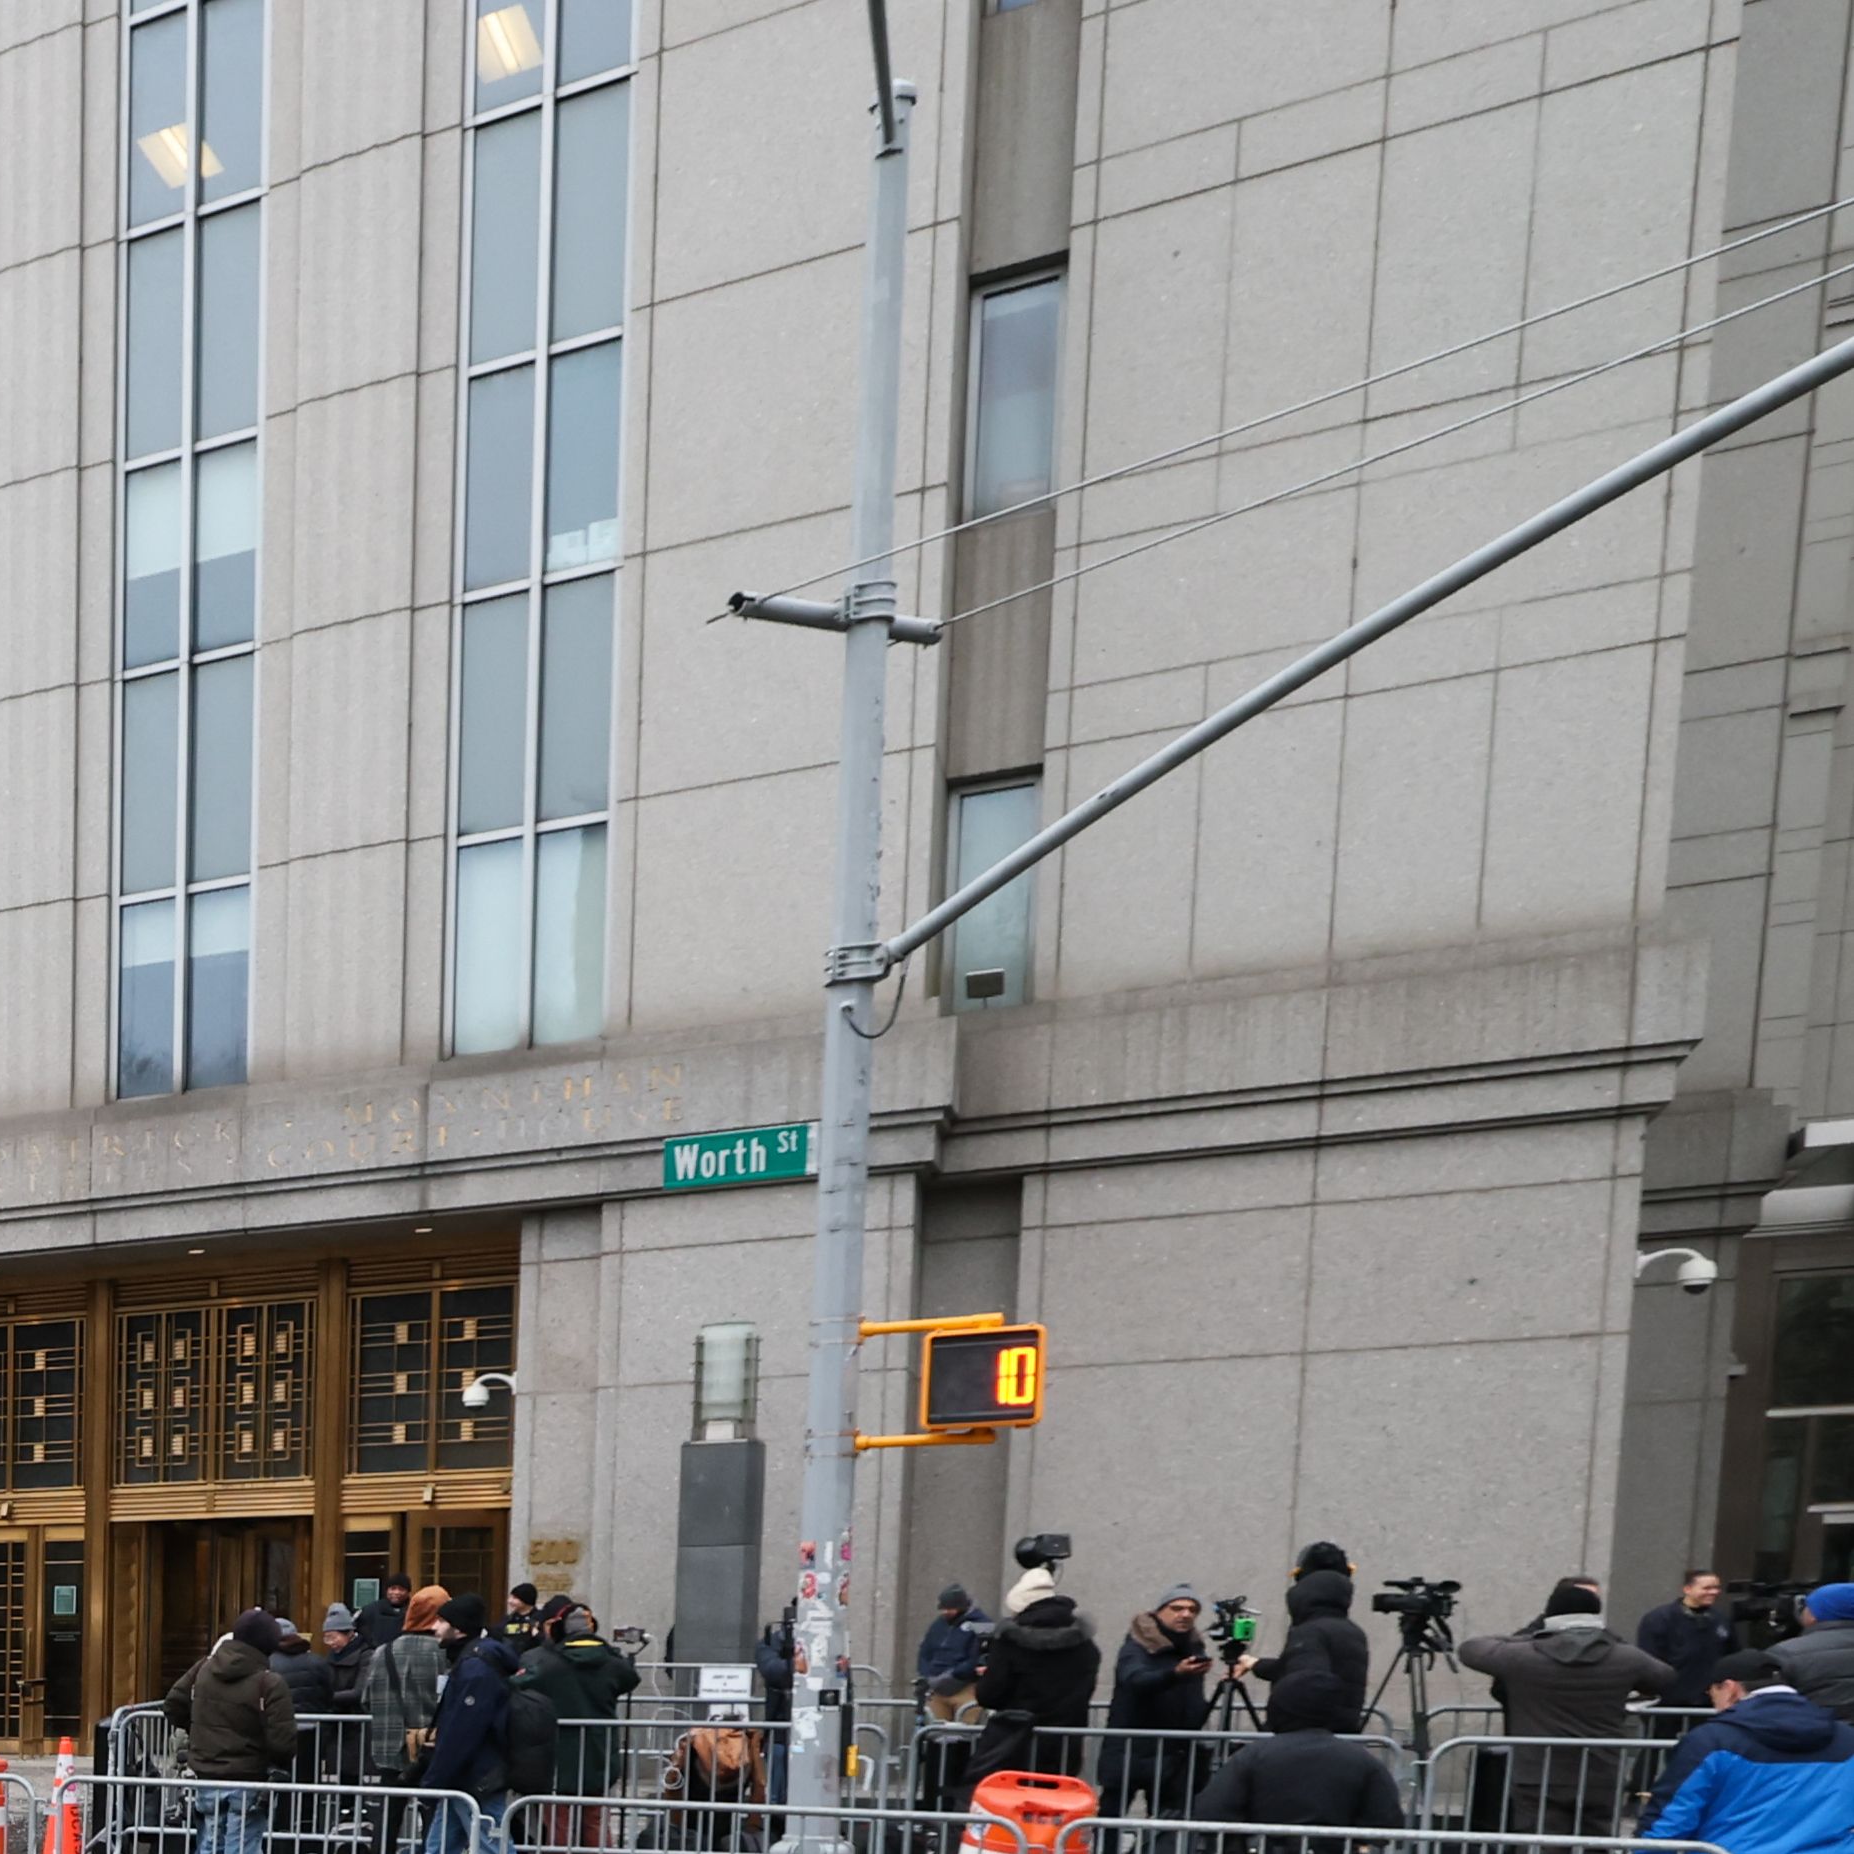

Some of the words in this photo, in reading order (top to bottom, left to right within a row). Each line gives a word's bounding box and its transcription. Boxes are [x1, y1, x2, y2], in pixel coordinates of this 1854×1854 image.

[673, 1136, 767, 1181] Worth
[777, 1130, 799, 1153] St
[997, 1346, 1037, 1405] 10
